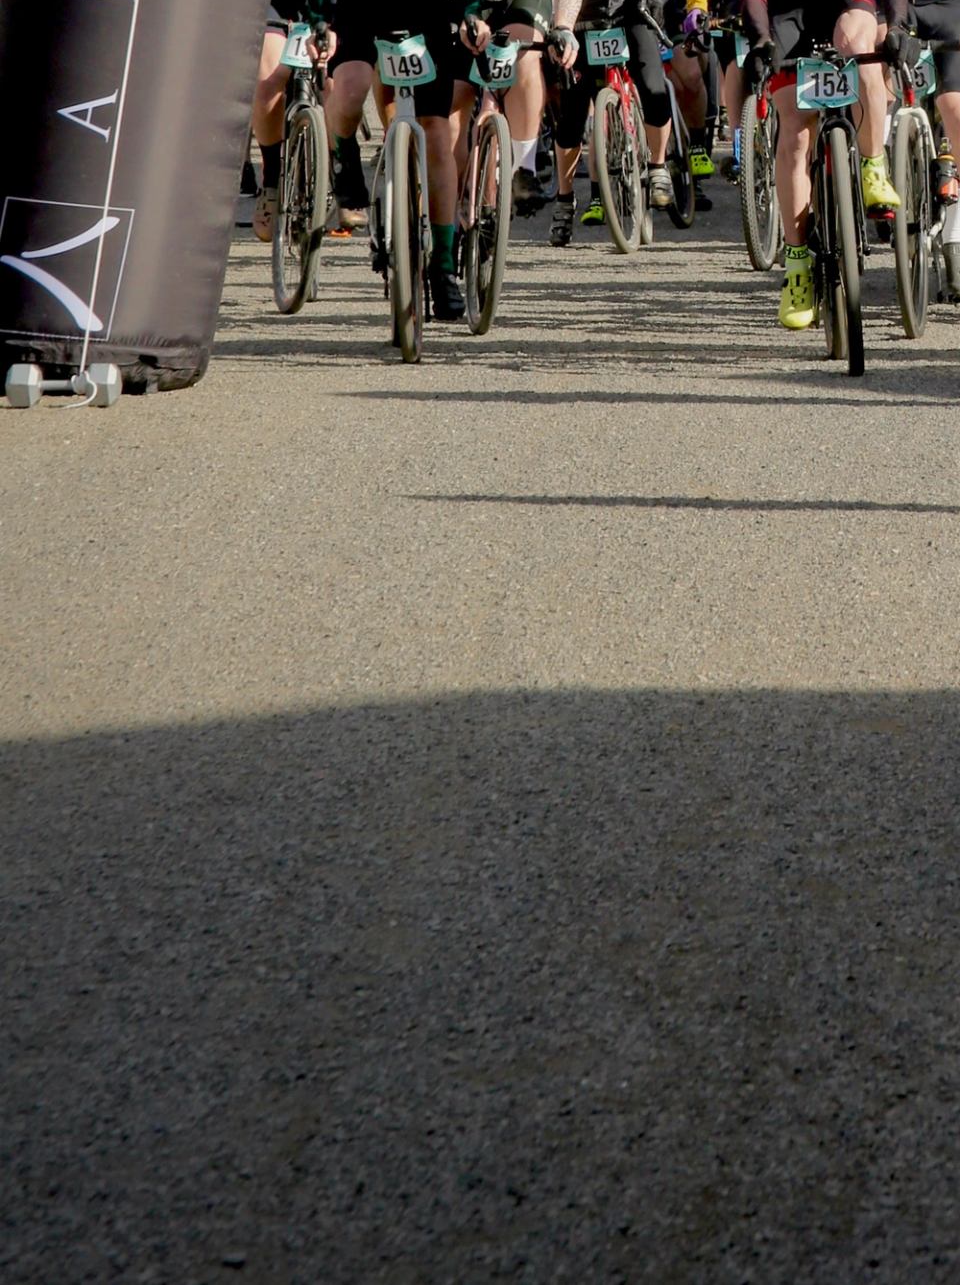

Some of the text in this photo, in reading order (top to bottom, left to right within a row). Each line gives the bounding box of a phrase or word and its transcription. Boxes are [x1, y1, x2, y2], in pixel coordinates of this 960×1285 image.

[594, 39, 620, 57] 152
[387, 54, 423, 77] 149
[487, 58, 512, 79] 55
[811, 72, 848, 97] 154
[893, 66, 925, 89] 15
